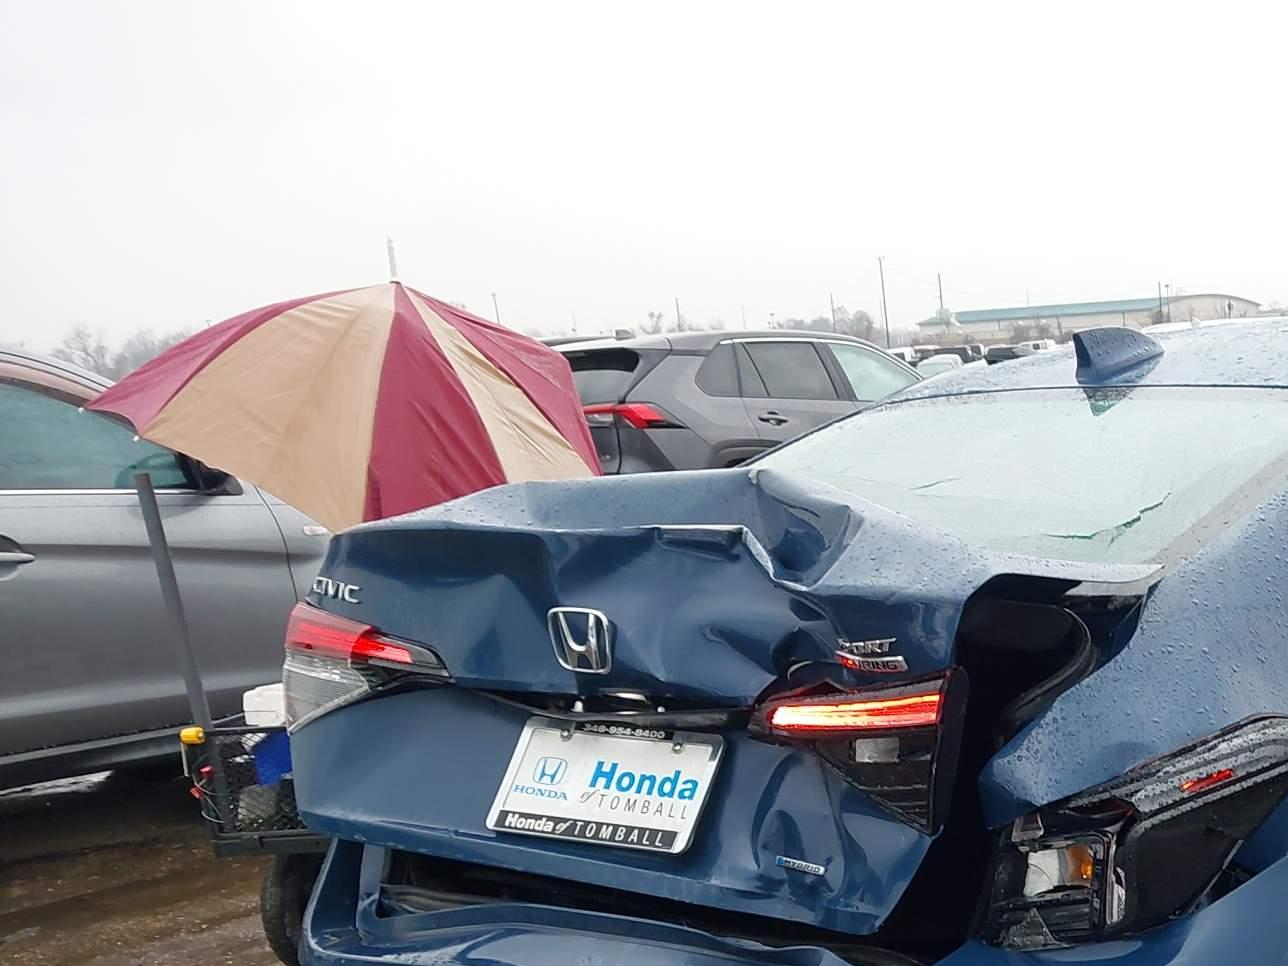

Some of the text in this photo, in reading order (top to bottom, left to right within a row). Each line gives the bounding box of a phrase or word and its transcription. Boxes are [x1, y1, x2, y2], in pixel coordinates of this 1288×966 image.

[313, 576, 360, 603] CIVIC
[837, 637, 897, 654] ORT
[513, 784, 568, 801] HONDA
[588, 760, 699, 801] Honda
[579, 789, 688, 820] of TOMBALL
[504, 813, 664, 847] Honda of TOMBALL
[785, 859, 821, 873] HYBRID
